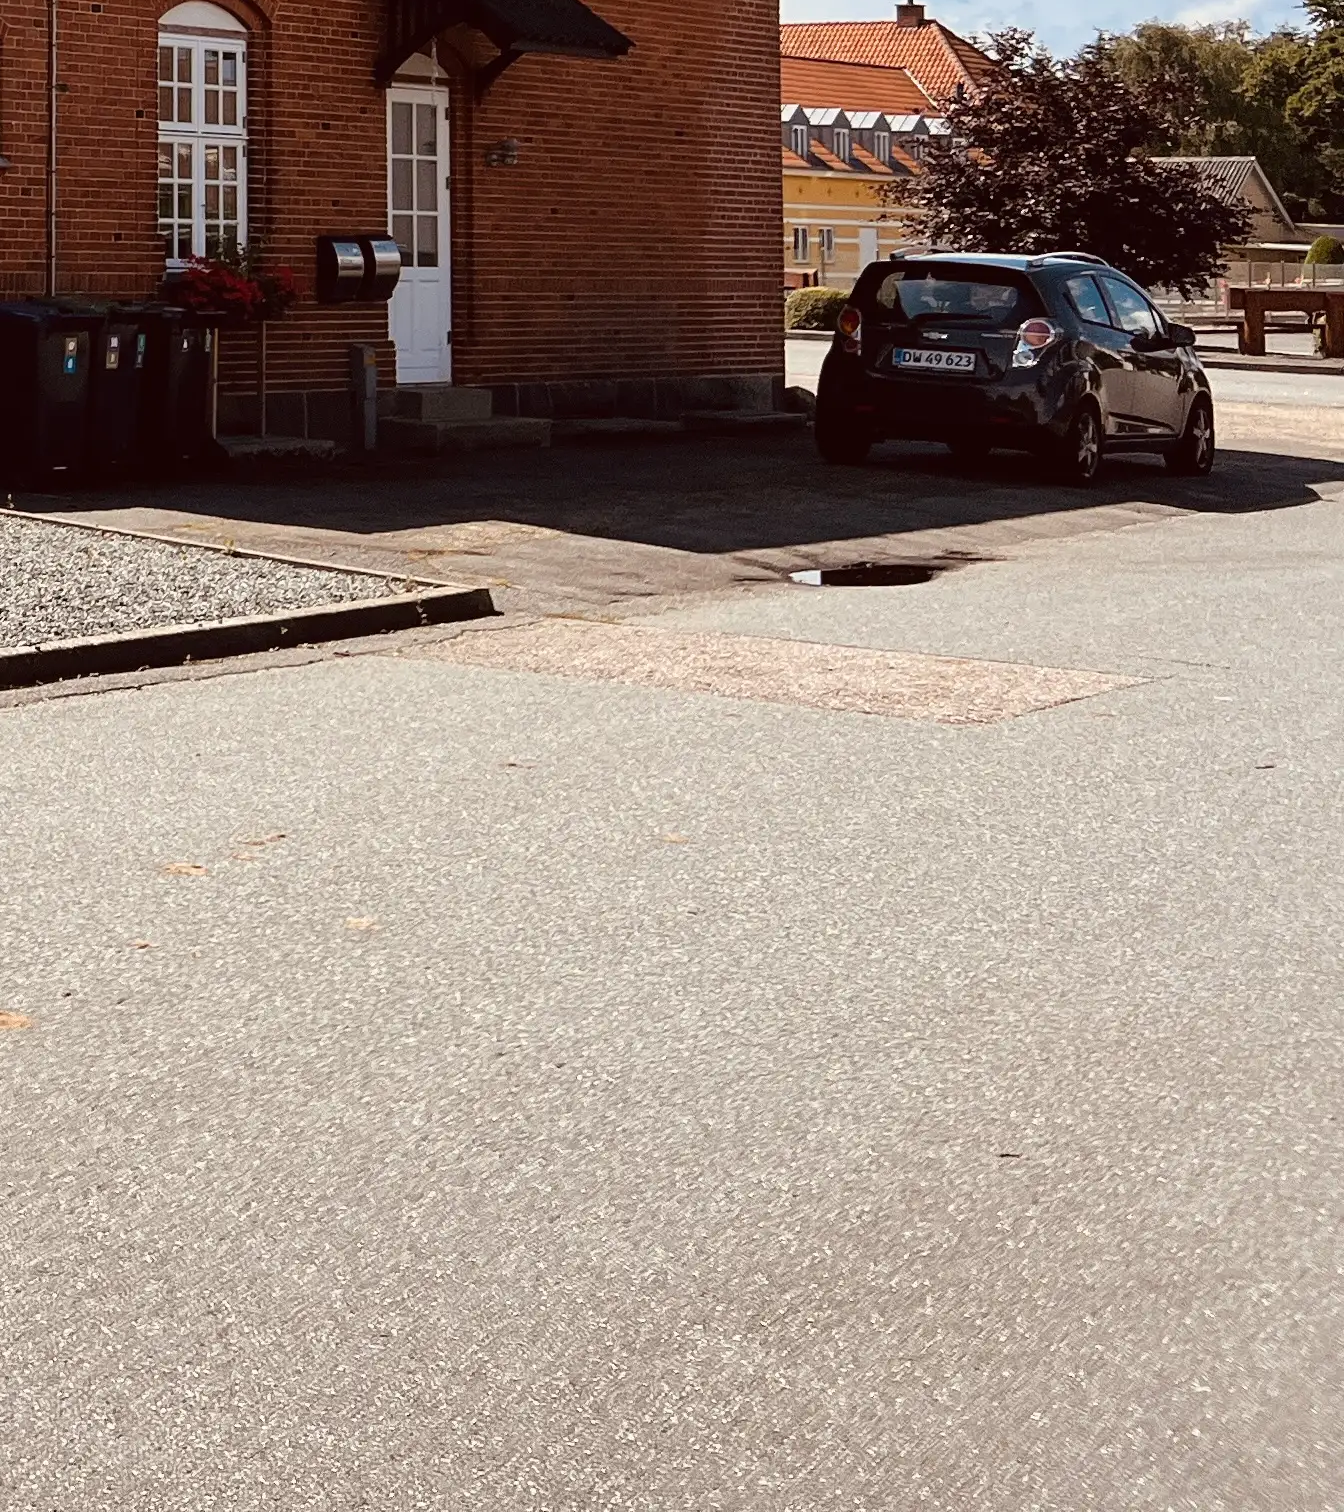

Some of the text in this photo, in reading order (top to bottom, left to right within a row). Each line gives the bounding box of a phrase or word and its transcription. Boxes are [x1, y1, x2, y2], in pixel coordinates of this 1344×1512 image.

[903, 351, 972, 367] DW 49 623
